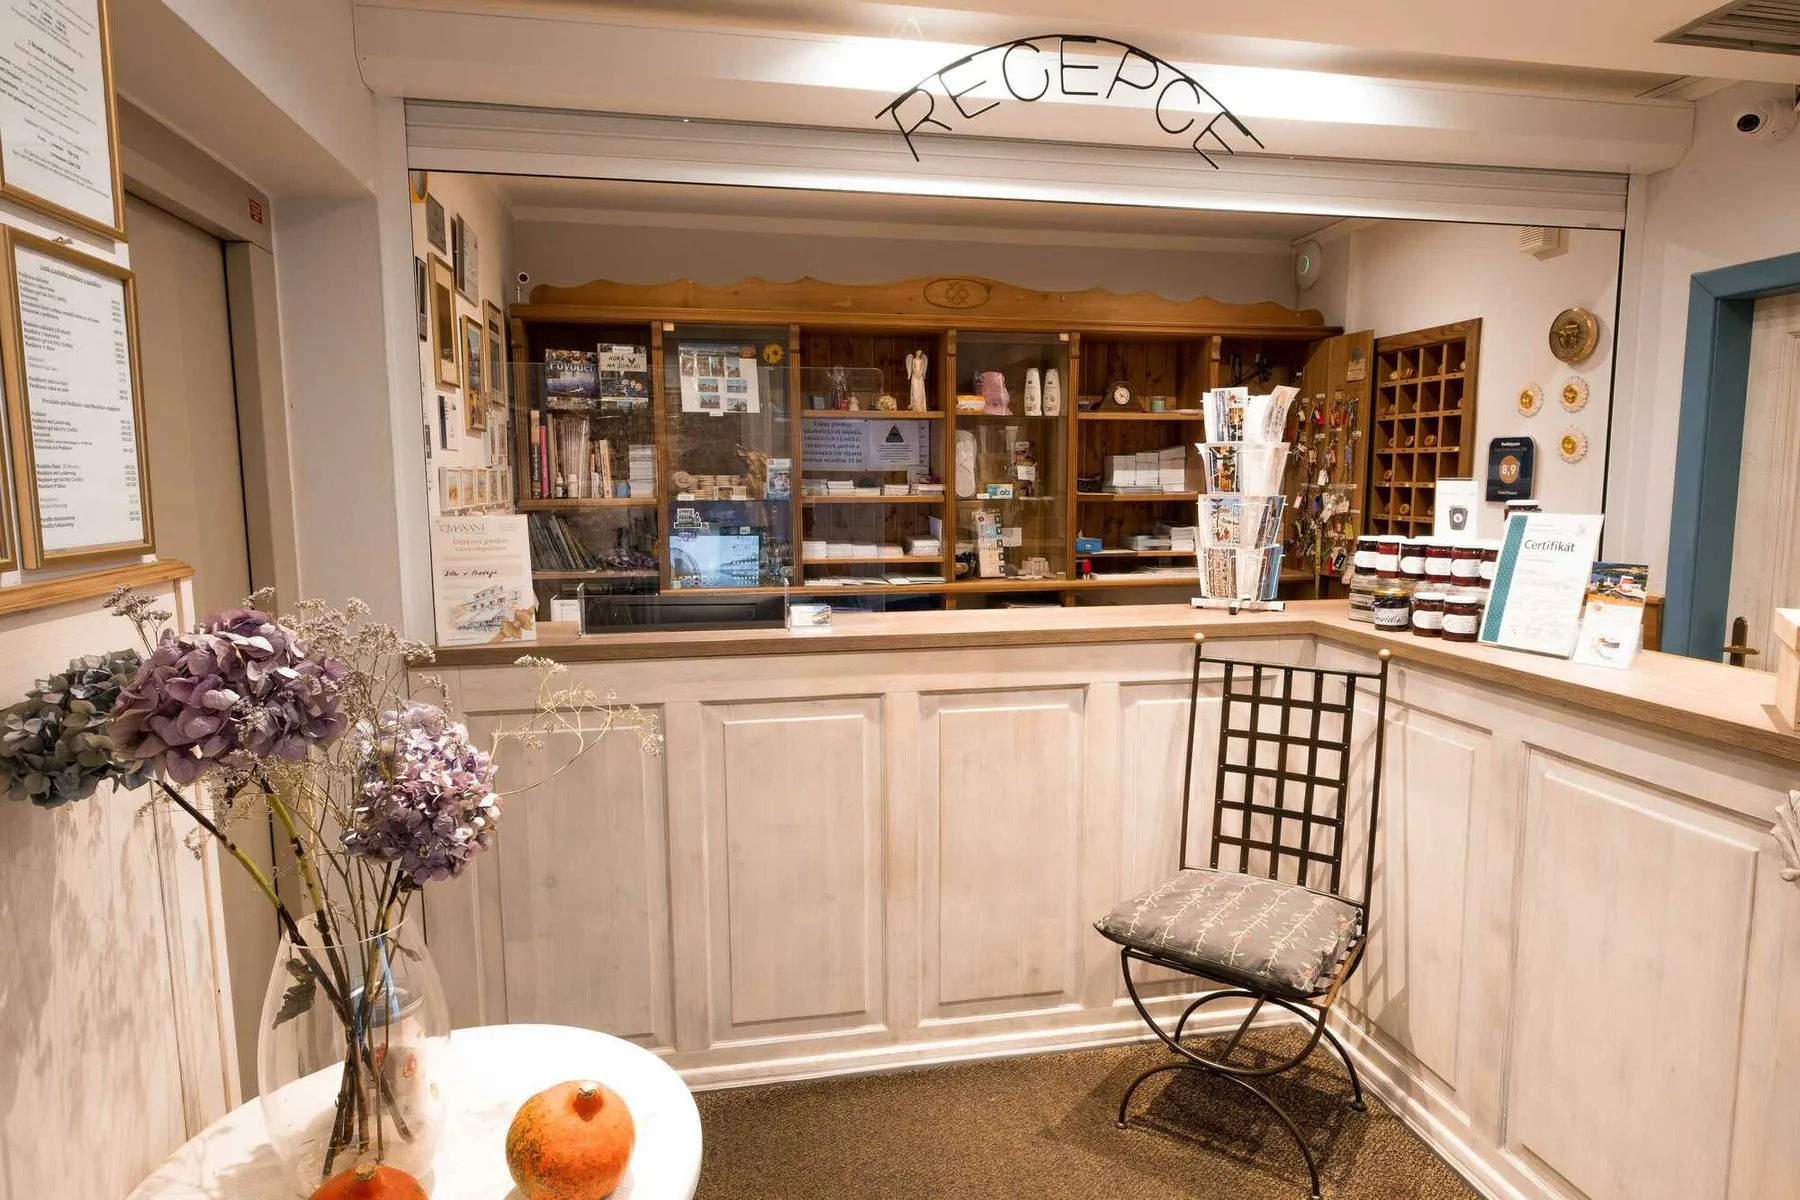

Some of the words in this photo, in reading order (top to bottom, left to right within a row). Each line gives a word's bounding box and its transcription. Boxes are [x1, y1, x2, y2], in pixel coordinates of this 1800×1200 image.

[888, 35, 1253, 170] RECEPCE
[1502, 464, 1517, 476] 8,9
[1524, 539, 1577, 553] Certifikát
